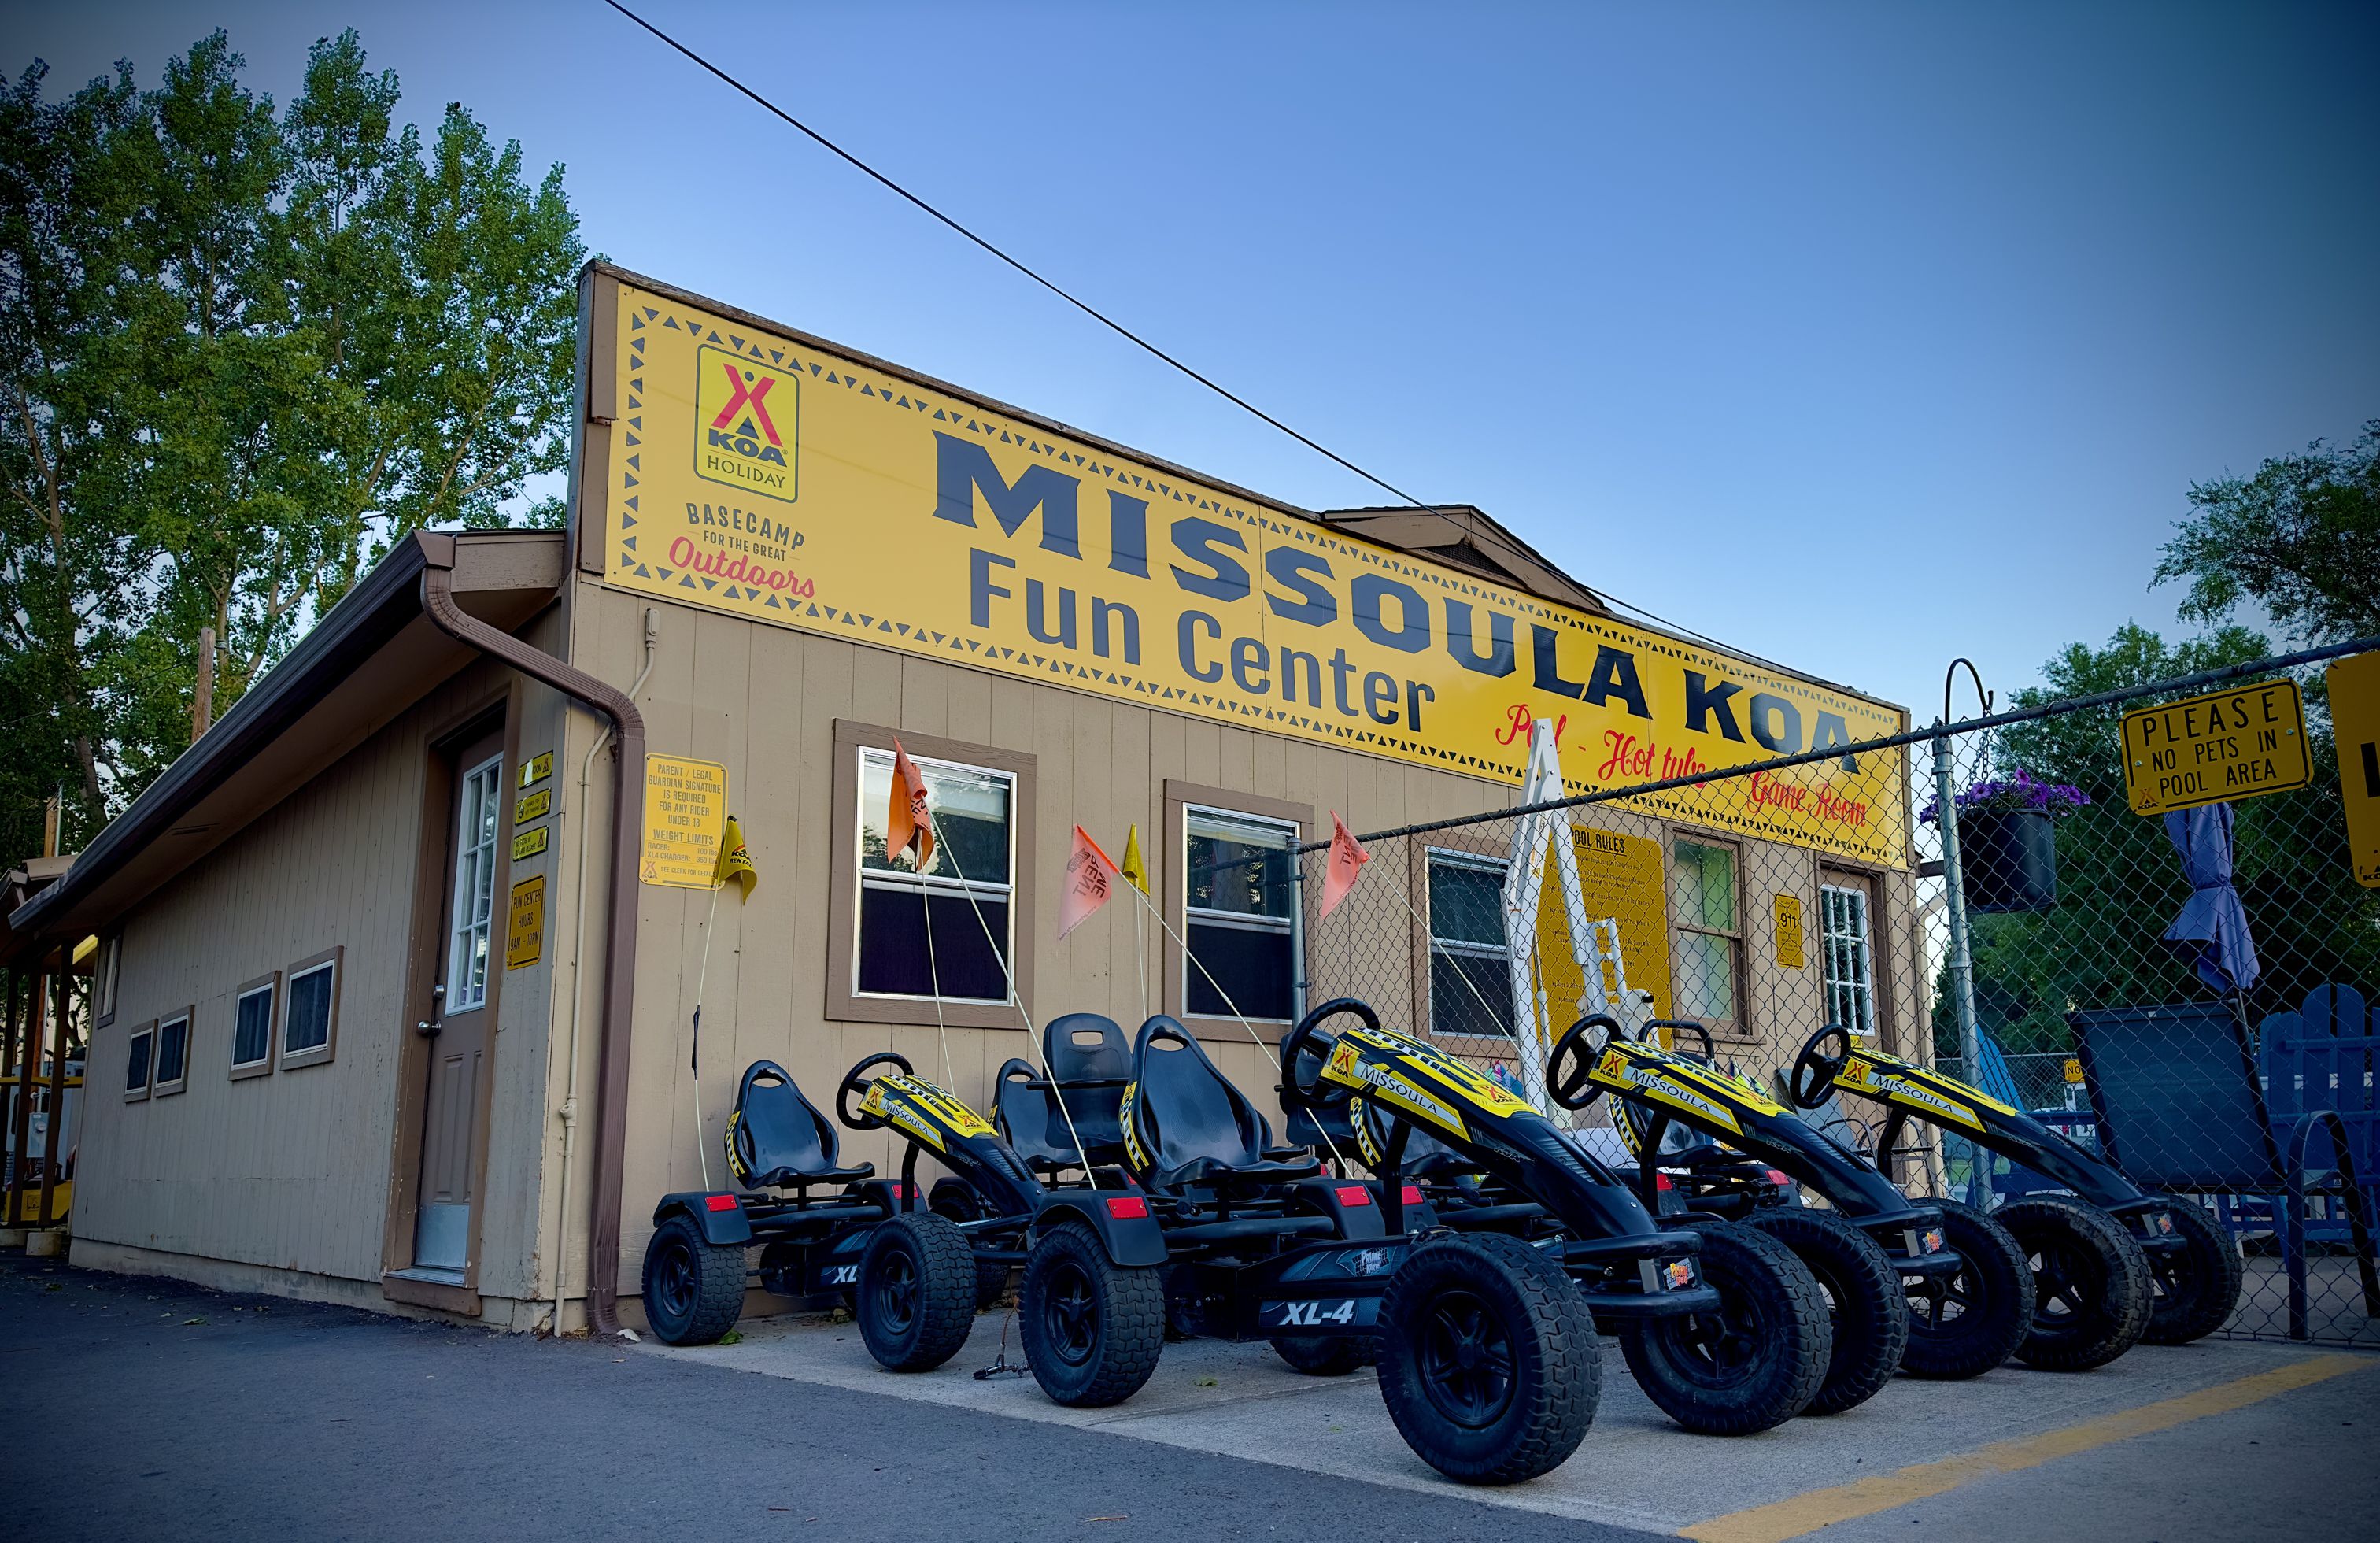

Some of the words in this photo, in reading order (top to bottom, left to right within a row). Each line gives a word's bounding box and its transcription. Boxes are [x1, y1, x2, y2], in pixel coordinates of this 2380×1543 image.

[708, 428, 787, 467] KOA
[707, 455, 785, 489] HOLIDAY
[686, 502, 804, 551] BASECAMP
[704, 530, 725, 547] FOR
[728, 535, 749, 553] THE
[752, 541, 786, 562] GREAT
[669, 535, 815, 599] Outdoors
[933, 430, 1653, 720] MISSOULA
[1683, 670, 1861, 775] KOA
[970, 547, 1140, 666] Fun
[1177, 610, 1436, 732] Center
[2142, 691, 2278, 747] PLEASE
[2152, 749, 2176, 772] NO
[2194, 736, 2239, 764] PETS
[2257, 728, 2278, 753] IN
[658, 764, 683, 777] PARENT
[693, 769, 712, 781] LEGAL
[1495, 704, 1567, 755] Pl
[1598, 729, 1655, 781] Hot
[1746, 772, 1806, 814] Game
[1808, 783, 1866, 827] Room
[2159, 771, 2208, 798] POOL
[2226, 758, 2277, 787] AREA
[649, 775, 682, 789] GUARDIAN
[685, 780, 721, 794] SIGNATURE
[663, 790, 670, 799] IS
[673, 791, 706, 804] REQUIRED
[659, 801, 672, 812] FOR
[674, 803, 688, 813] ANY
[690, 805, 709, 816] RIDER
[668, 815, 690, 827] UNDER
[693, 818, 700, 827] 18
[648, 842, 670, 851] RACER:
[708, 848, 718, 857] lbs
[653, 829, 684, 842] WEIGHT
[687, 834, 714, 845] LIMITS
[1596, 834, 1625, 853] RULES
[660, 853, 691, 862] CHARGER:
[513, 895, 522, 909] FUN
[524, 888, 541, 907] CENTER
[519, 912, 534, 928] HOURS
[1780, 912, 1797, 929] 911
[511, 936, 520, 951] 9AM
[527, 931, 539, 947] 10PM
[2067, 1066, 2081, 1075] NO
[1331, 1066, 1350, 1079] KOA
[1360, 1065, 1437, 1114] MISSOULA
[1599, 1068, 1619, 1081] KOA
[1630, 1069, 1709, 1112] MISSOULA
[1843, 1075, 1862, 1086] KOA
[1873, 1075, 1953, 1112] MISSOULA
[866, 1101, 877, 1110] KOA
[883, 1101, 929, 1134] MISSOULA
[1277, 1300, 1355, 1326] XL-4
